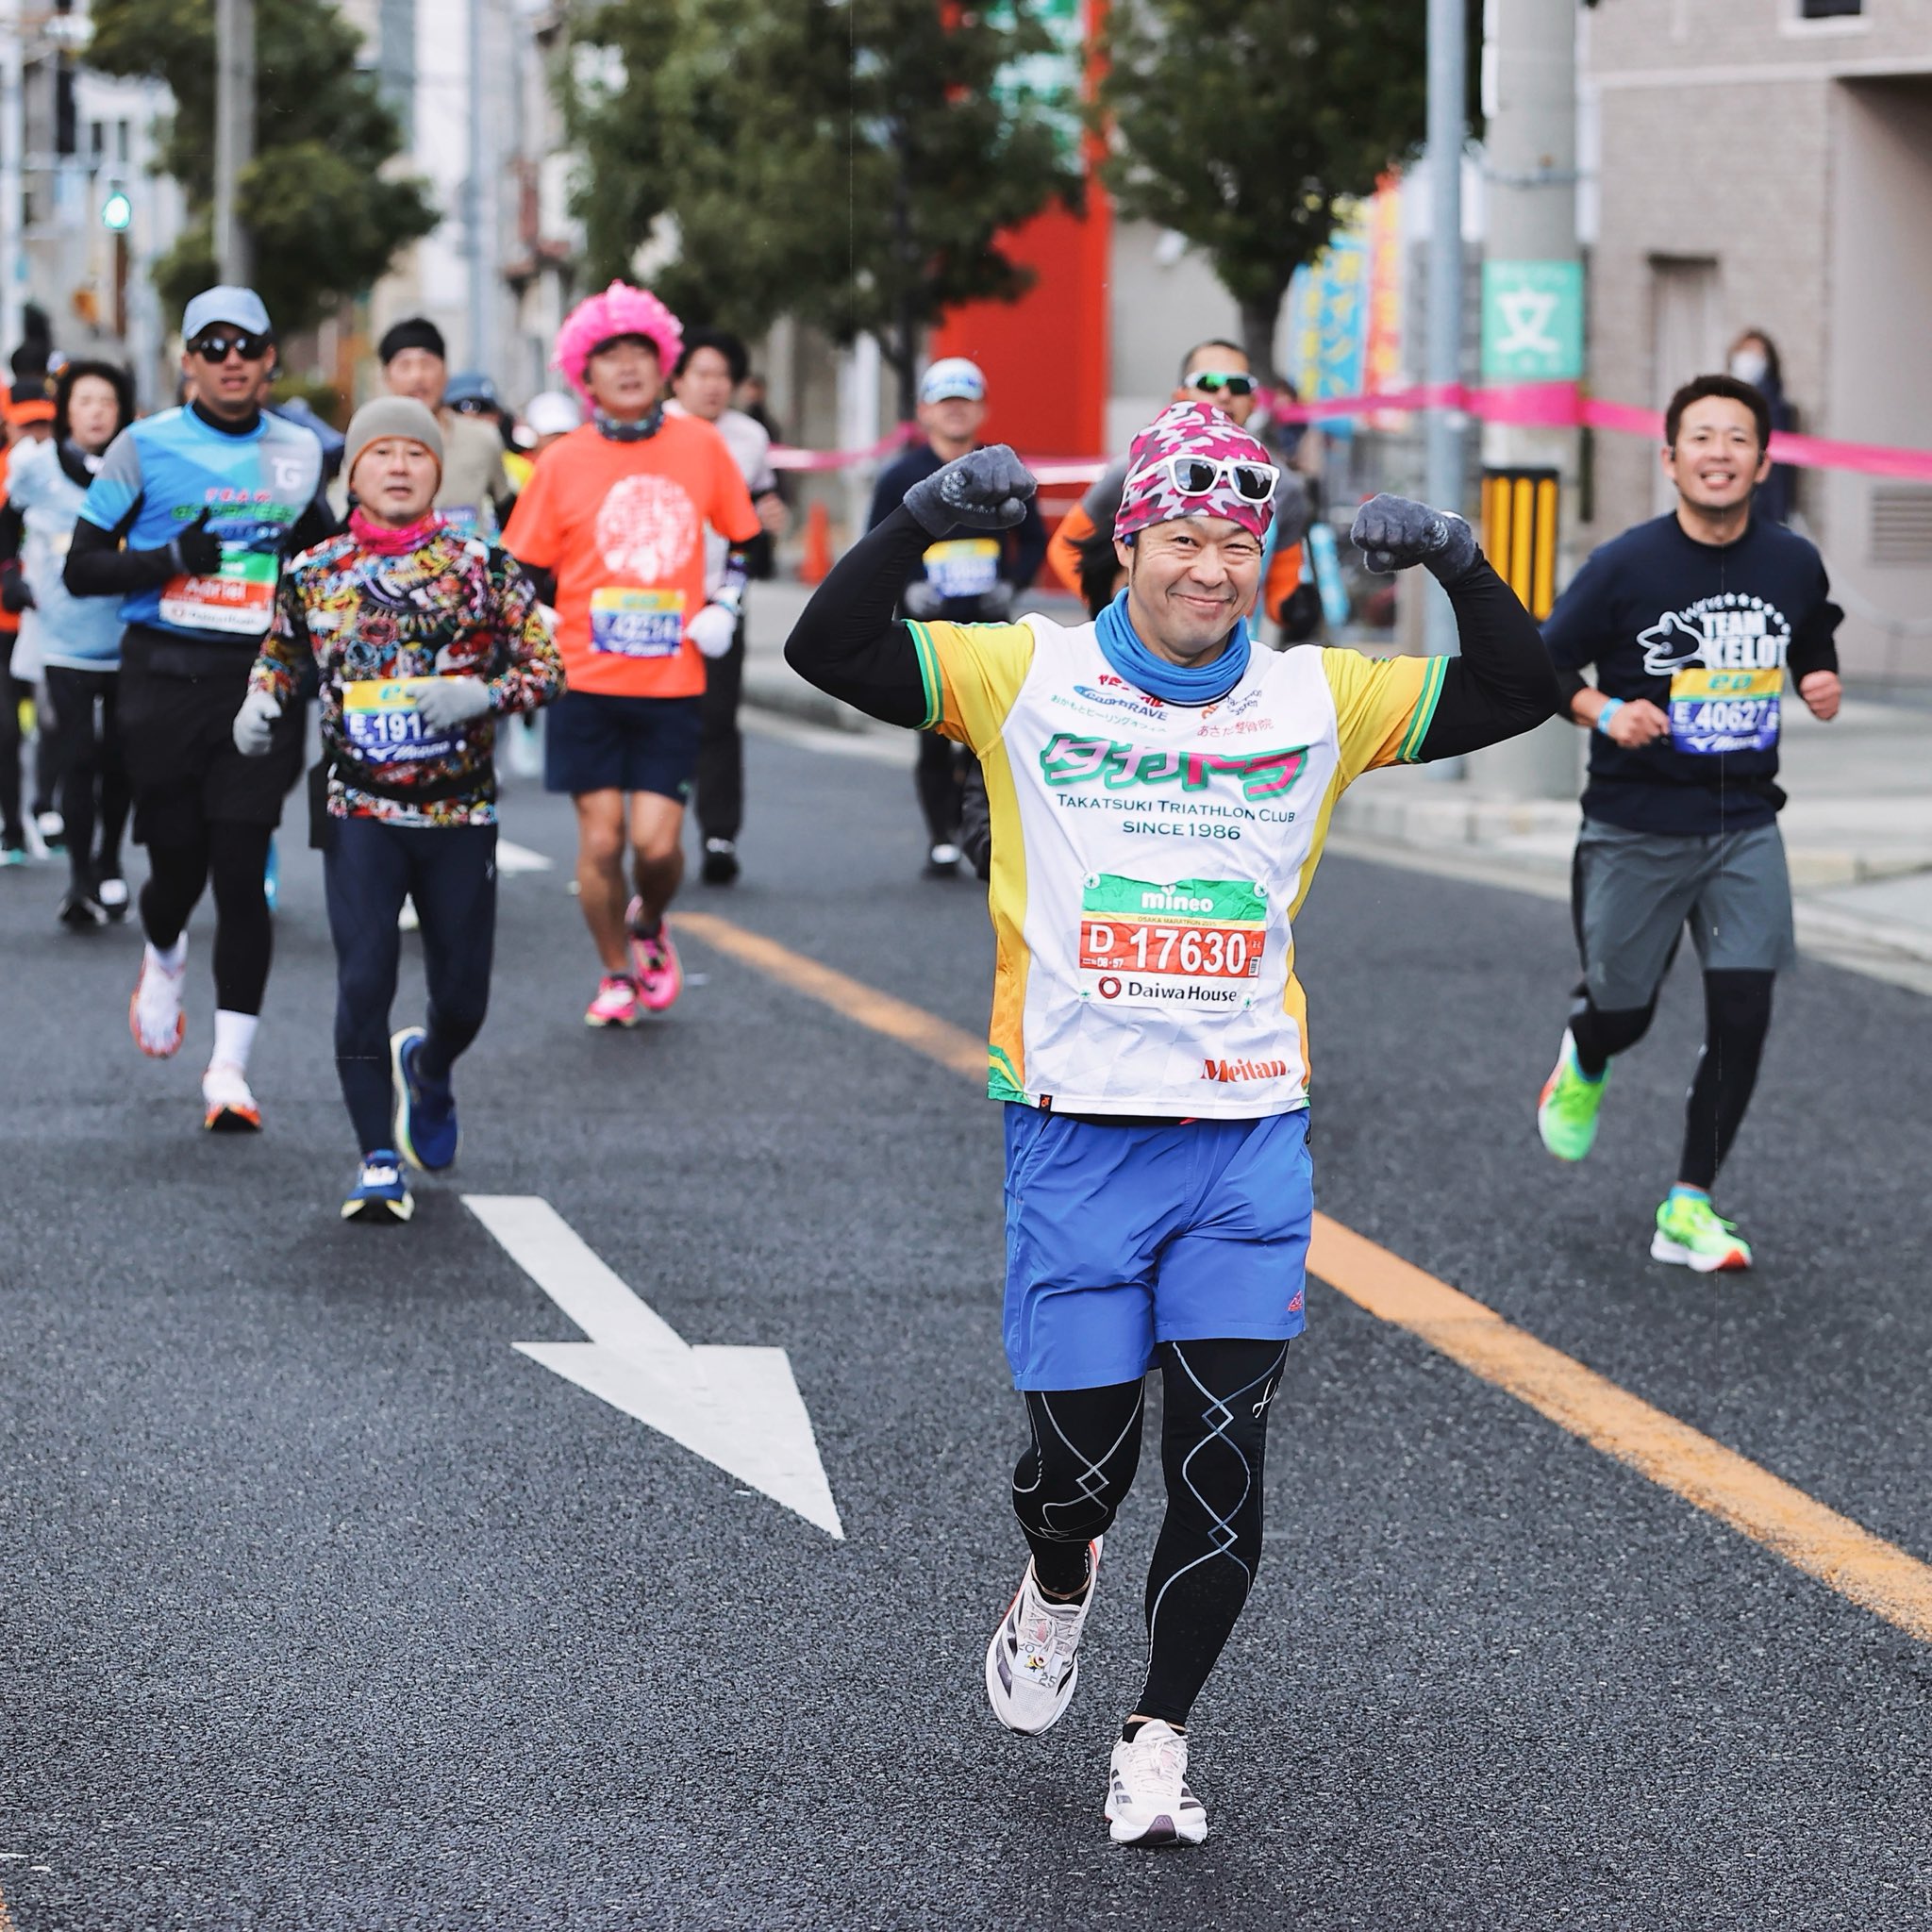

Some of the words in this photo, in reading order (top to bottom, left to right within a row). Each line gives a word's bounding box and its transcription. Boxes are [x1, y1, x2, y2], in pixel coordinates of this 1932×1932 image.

[1494, 286, 1560, 355] 文
[1699, 610, 1766, 637] TEAM
[350, 712, 367, 735] E
[1674, 701, 1691, 724] E
[1695, 699, 1769, 733] 40627
[1057, 793, 1152, 812] TAKATSUKI
[1158, 800, 1256, 821] TRIATHLON
[1259, 808, 1295, 823] CLUB
[1141, 885, 1214, 913] mineo
[1089, 924, 1115, 954] D
[1130, 927, 1247, 975] 17630
[1200, 1058, 1287, 1082] Meitan
[1039, 1673, 1058, 1688] 25
